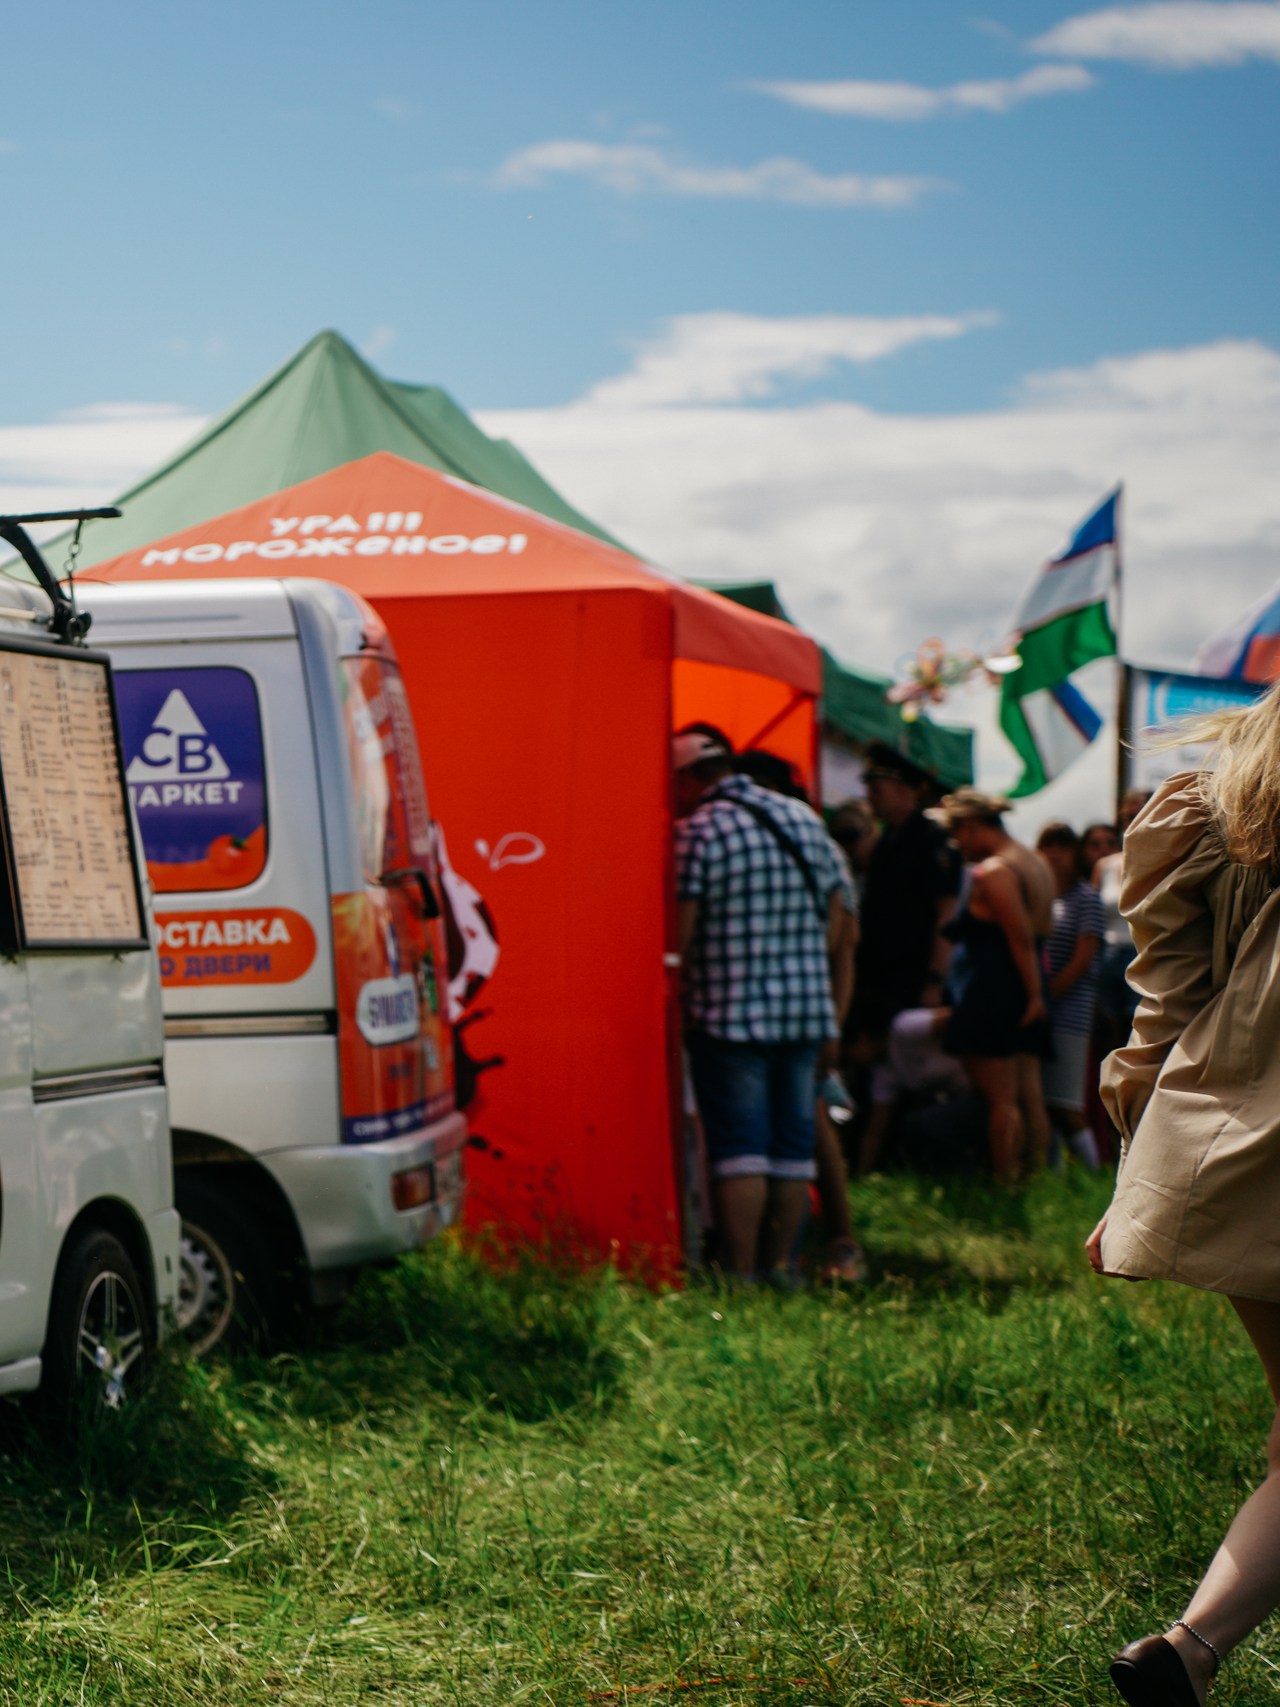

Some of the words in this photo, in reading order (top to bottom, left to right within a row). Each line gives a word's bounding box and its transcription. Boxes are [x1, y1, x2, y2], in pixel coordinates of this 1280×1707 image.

[270, 511, 423, 536] УРА!!!
[136, 727, 214, 775] СВ
[184, 953, 273, 979] ДВЕРИ
